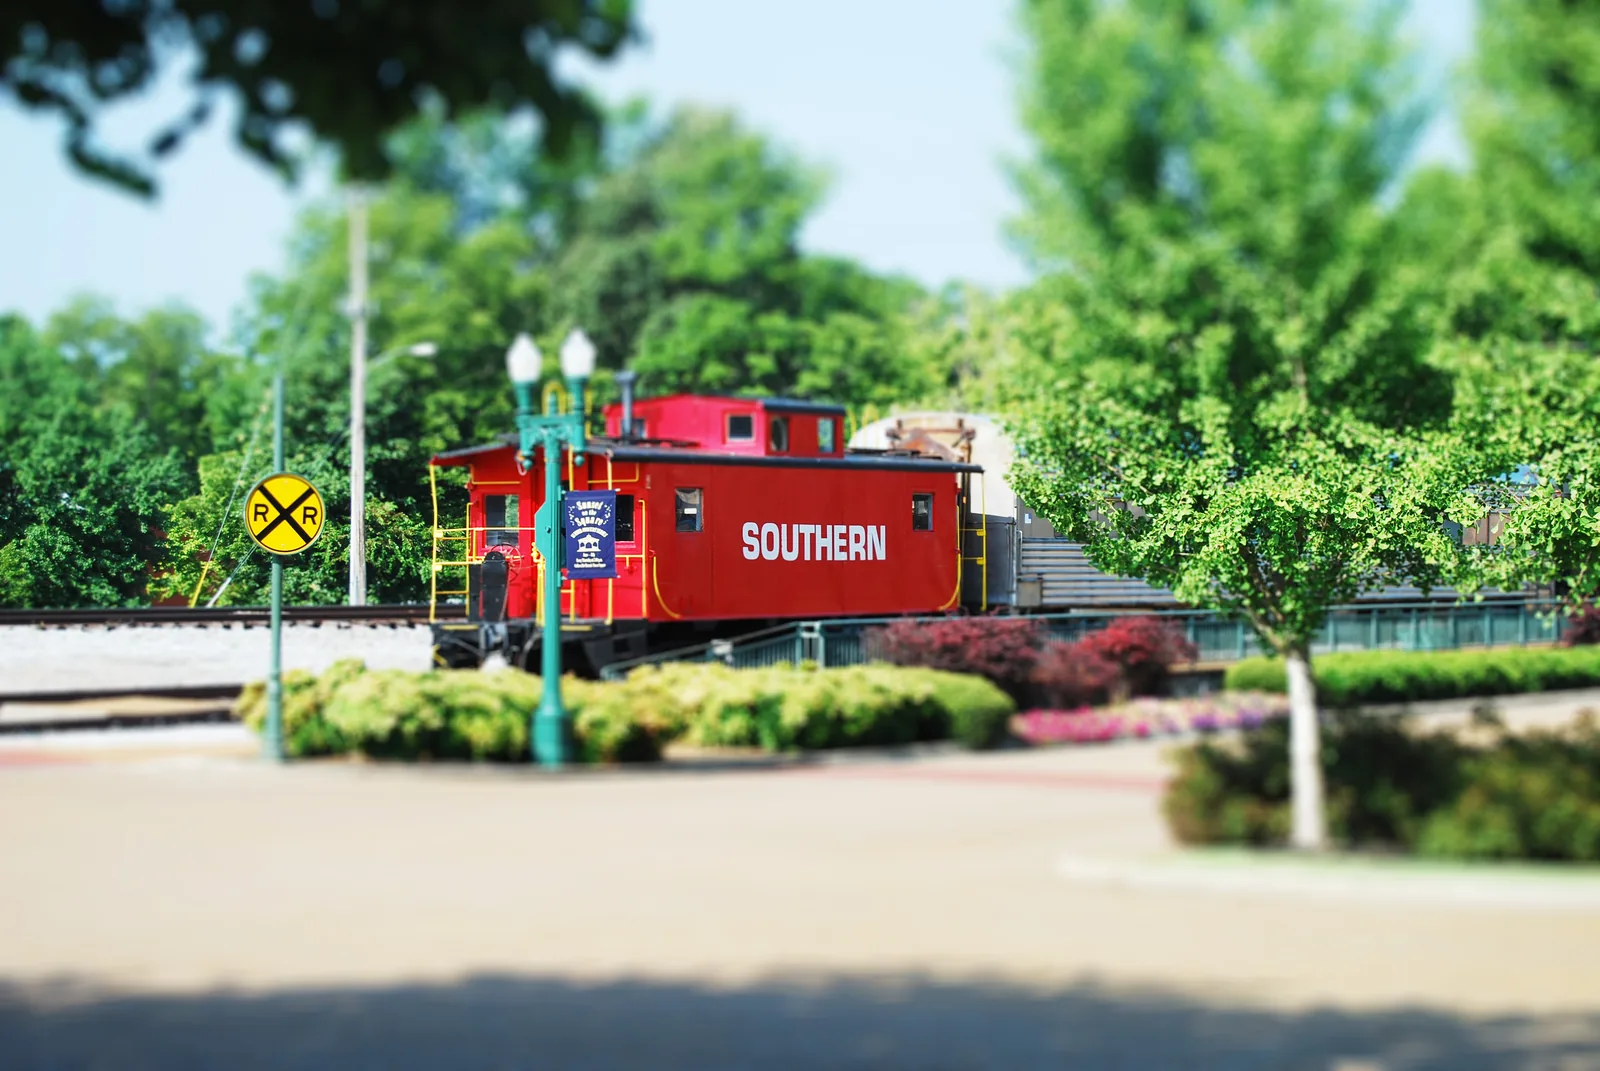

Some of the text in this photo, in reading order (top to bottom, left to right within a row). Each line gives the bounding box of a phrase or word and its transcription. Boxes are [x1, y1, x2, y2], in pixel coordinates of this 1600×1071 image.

[576, 501, 604, 510] Sunset
[254, 503, 318, 525] R R
[574, 517, 604, 526] Square
[742, 521, 886, 561] SOUTHERN
